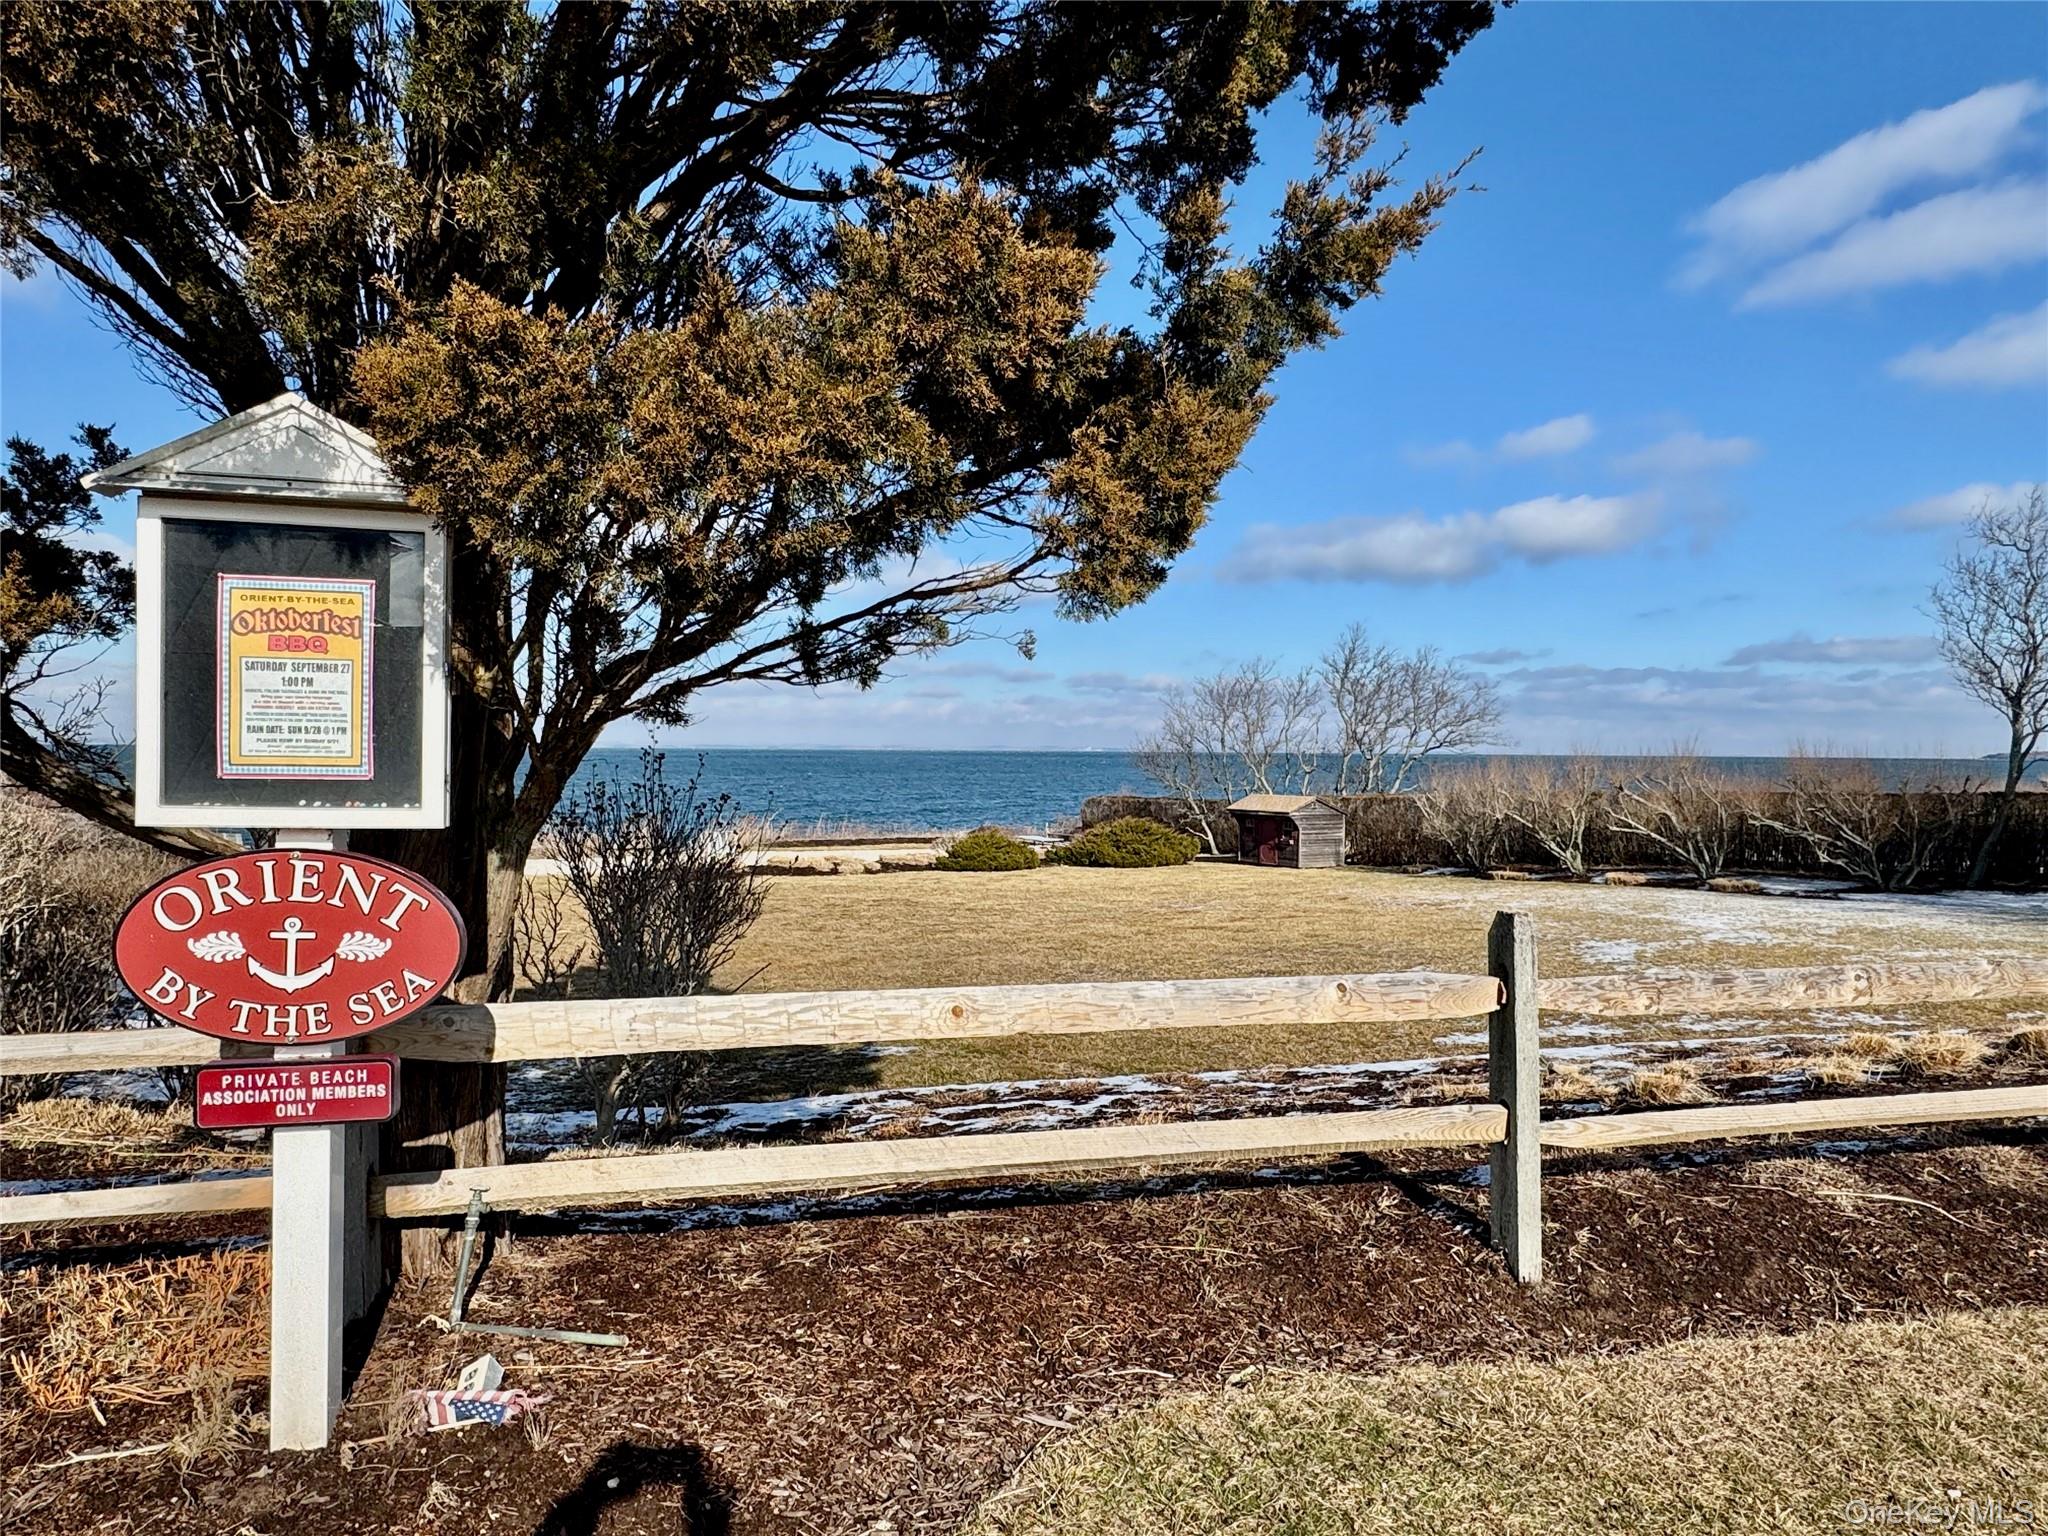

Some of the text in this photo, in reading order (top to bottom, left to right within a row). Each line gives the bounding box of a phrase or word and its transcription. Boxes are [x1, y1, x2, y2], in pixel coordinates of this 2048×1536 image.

[240, 594, 355, 606] ORIENT-BY-THE-SEA
[232, 607, 362, 639] Oktoberfest
[268, 634, 330, 654] BBQ
[244, 660, 351, 674] SATURDAY SEPTEMBER 27
[281, 676, 314, 687] 1:00 PM
[246, 724, 265, 734] RAIN
[287, 725, 303, 735] SUN
[304, 725, 322, 735] 9/28
[152, 859, 431, 932] ORIENT
[143, 967, 438, 1038] BY THE SEA
[221, 1069, 368, 1089] PRIVATE BEACH
[202, 1084, 387, 1107] ASSOCIATION MEMBERS
[275, 1102, 316, 1118] ONLY
